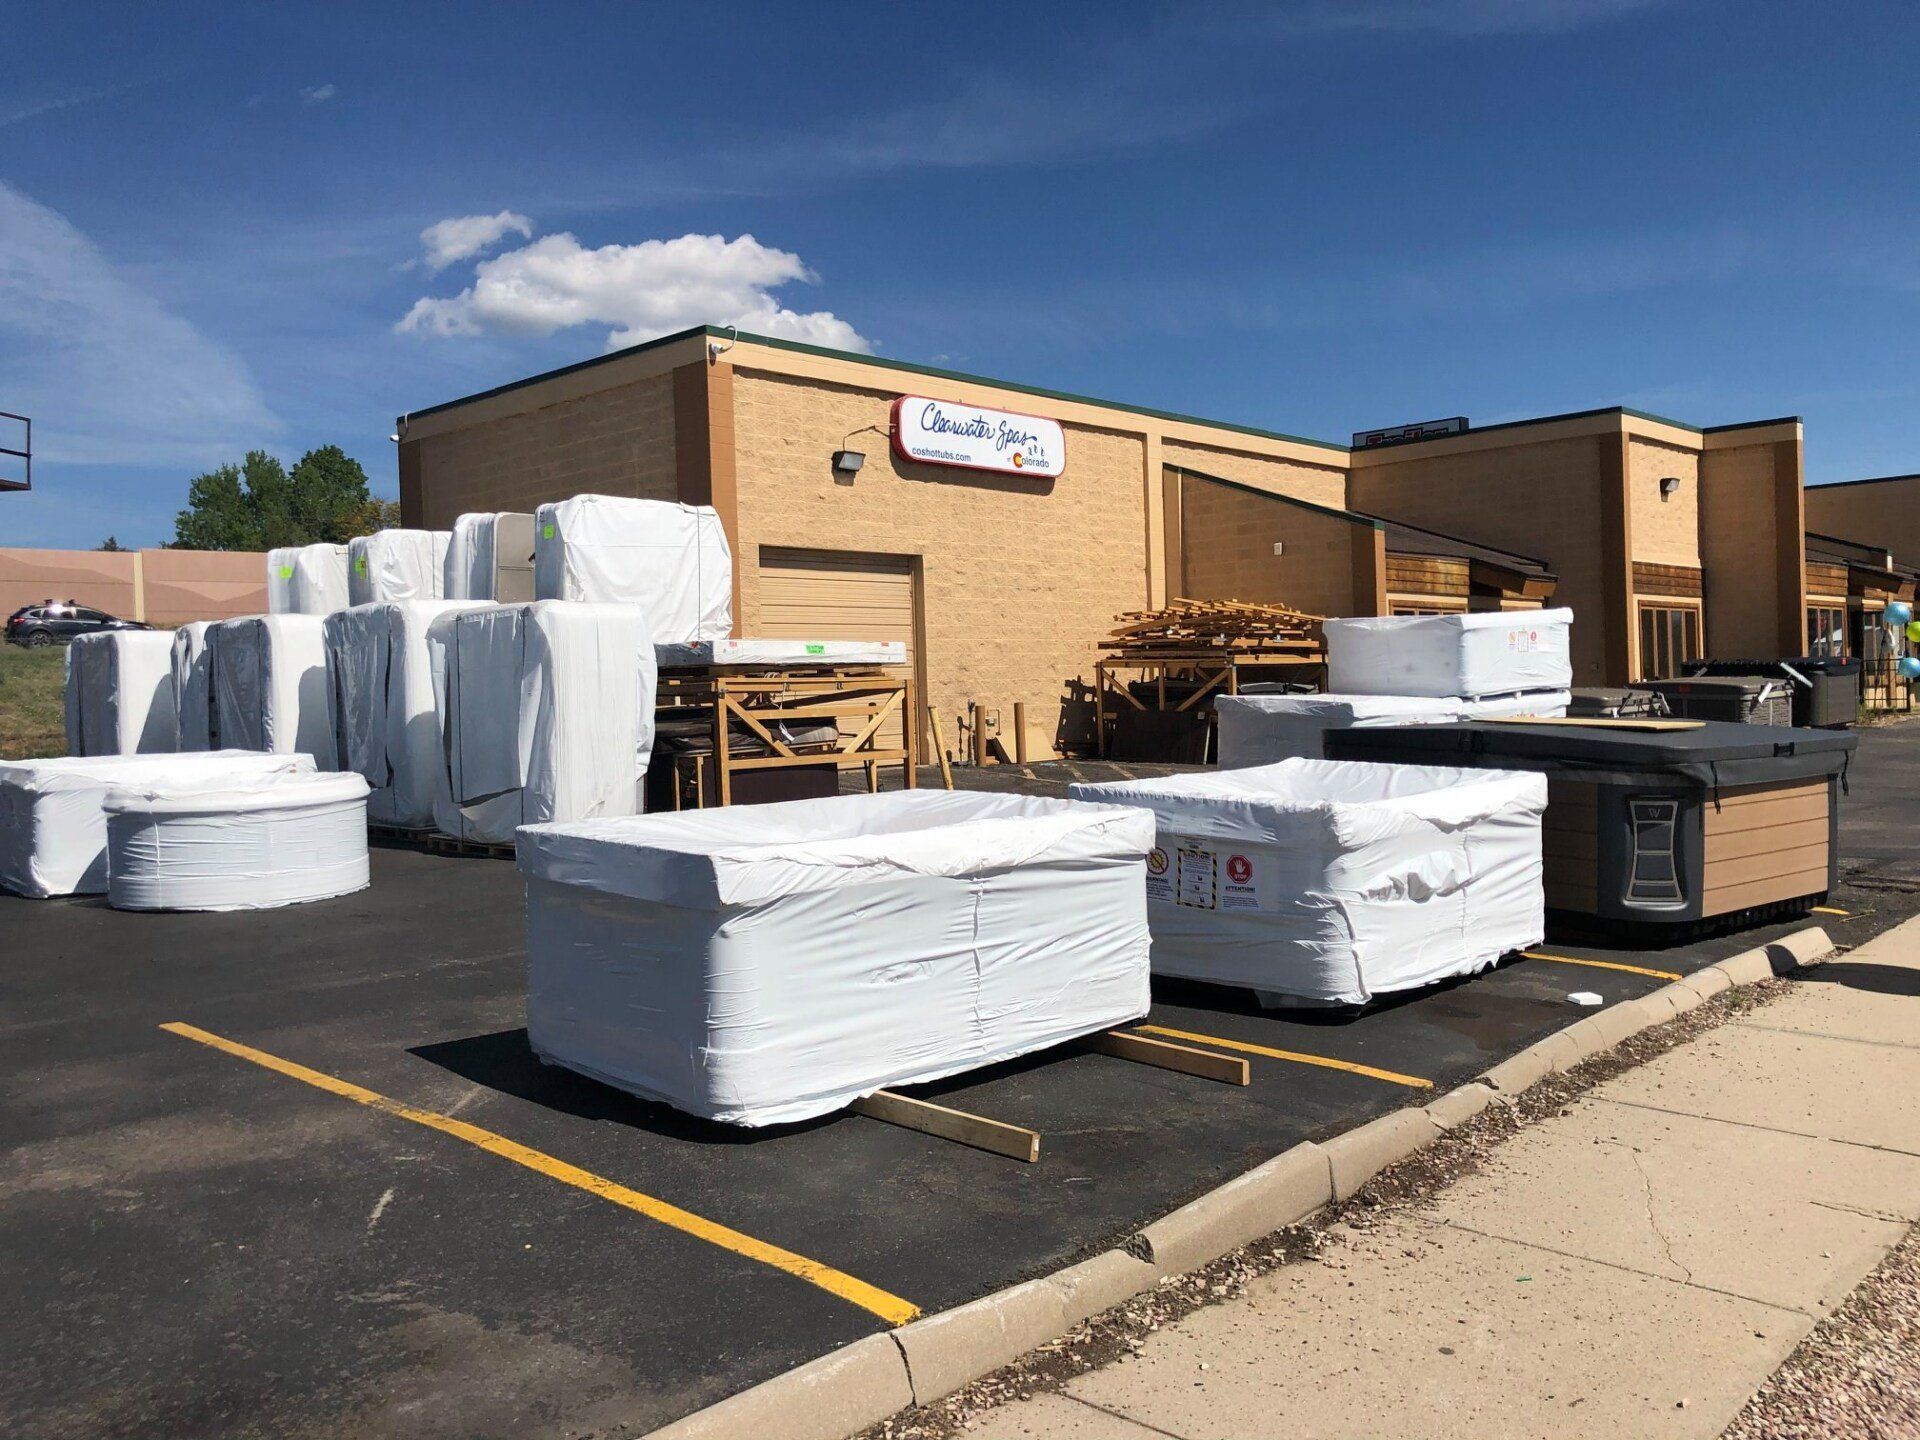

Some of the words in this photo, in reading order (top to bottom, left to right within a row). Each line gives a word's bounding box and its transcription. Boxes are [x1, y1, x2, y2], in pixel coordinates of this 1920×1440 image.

[921, 402, 996, 440] Clearwater
[996, 420, 1037, 451] Spas
[911, 446, 972, 462] coshottubs.com
[1013, 452, 1050, 468] Colorado
